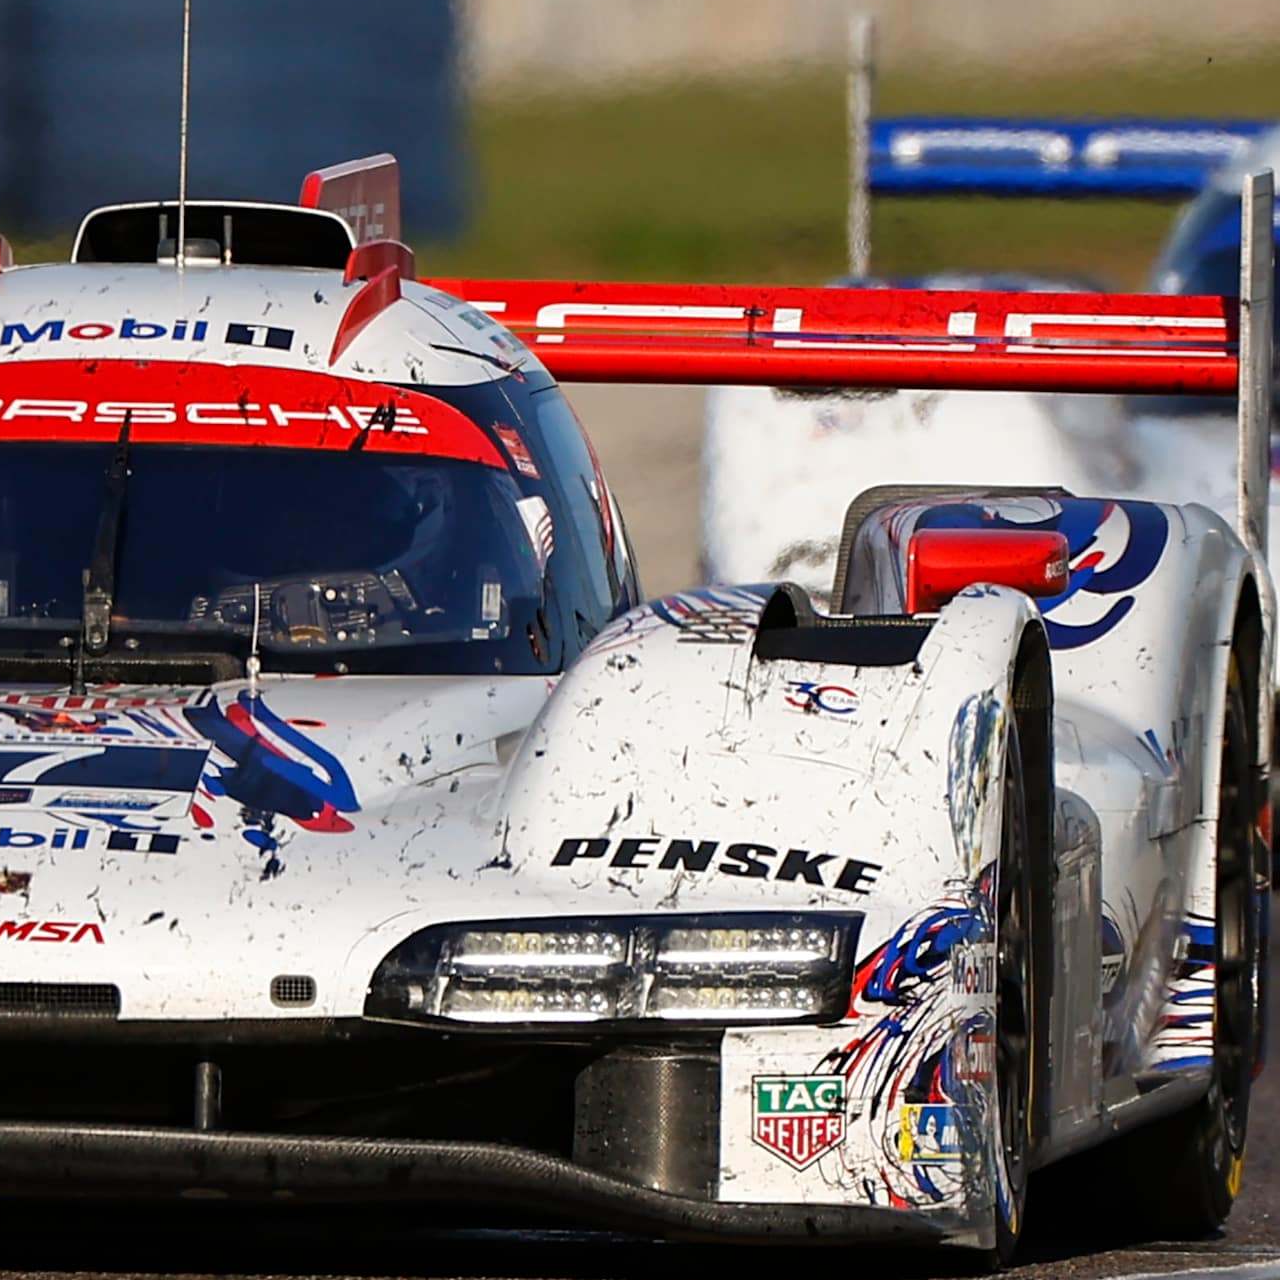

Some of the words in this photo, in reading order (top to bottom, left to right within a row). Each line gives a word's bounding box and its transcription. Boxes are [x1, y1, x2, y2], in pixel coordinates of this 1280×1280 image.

[0, 318, 209, 346] Mobil
[550, 838, 884, 896] PENSKE
[760, 1082, 839, 1111] TAG
[759, 1118, 841, 1161] HEUER
